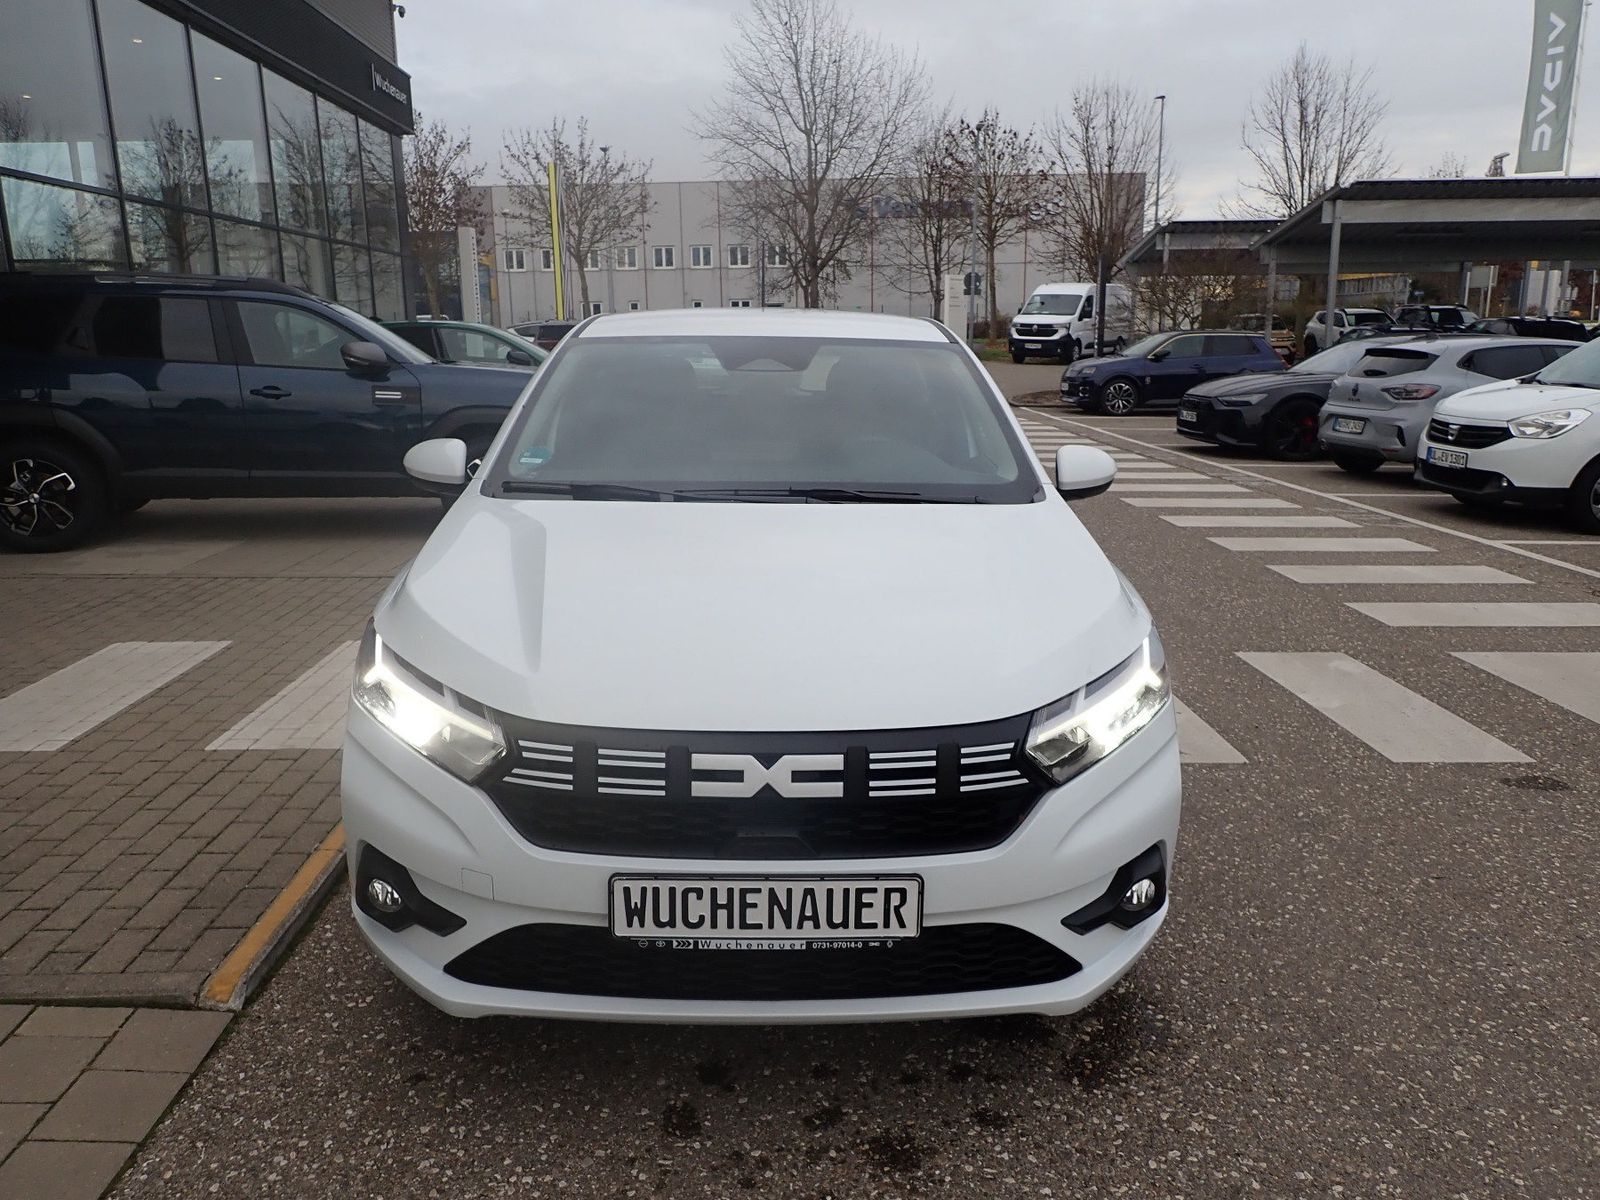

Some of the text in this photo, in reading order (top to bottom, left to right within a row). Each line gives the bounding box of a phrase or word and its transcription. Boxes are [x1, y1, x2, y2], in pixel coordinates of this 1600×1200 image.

[374, 71, 407, 104] Wuchenauer
[622, 886, 908, 930] WUCHENAUER
[700, 939, 863, 950] Wuchenauer 0731-97014-0
